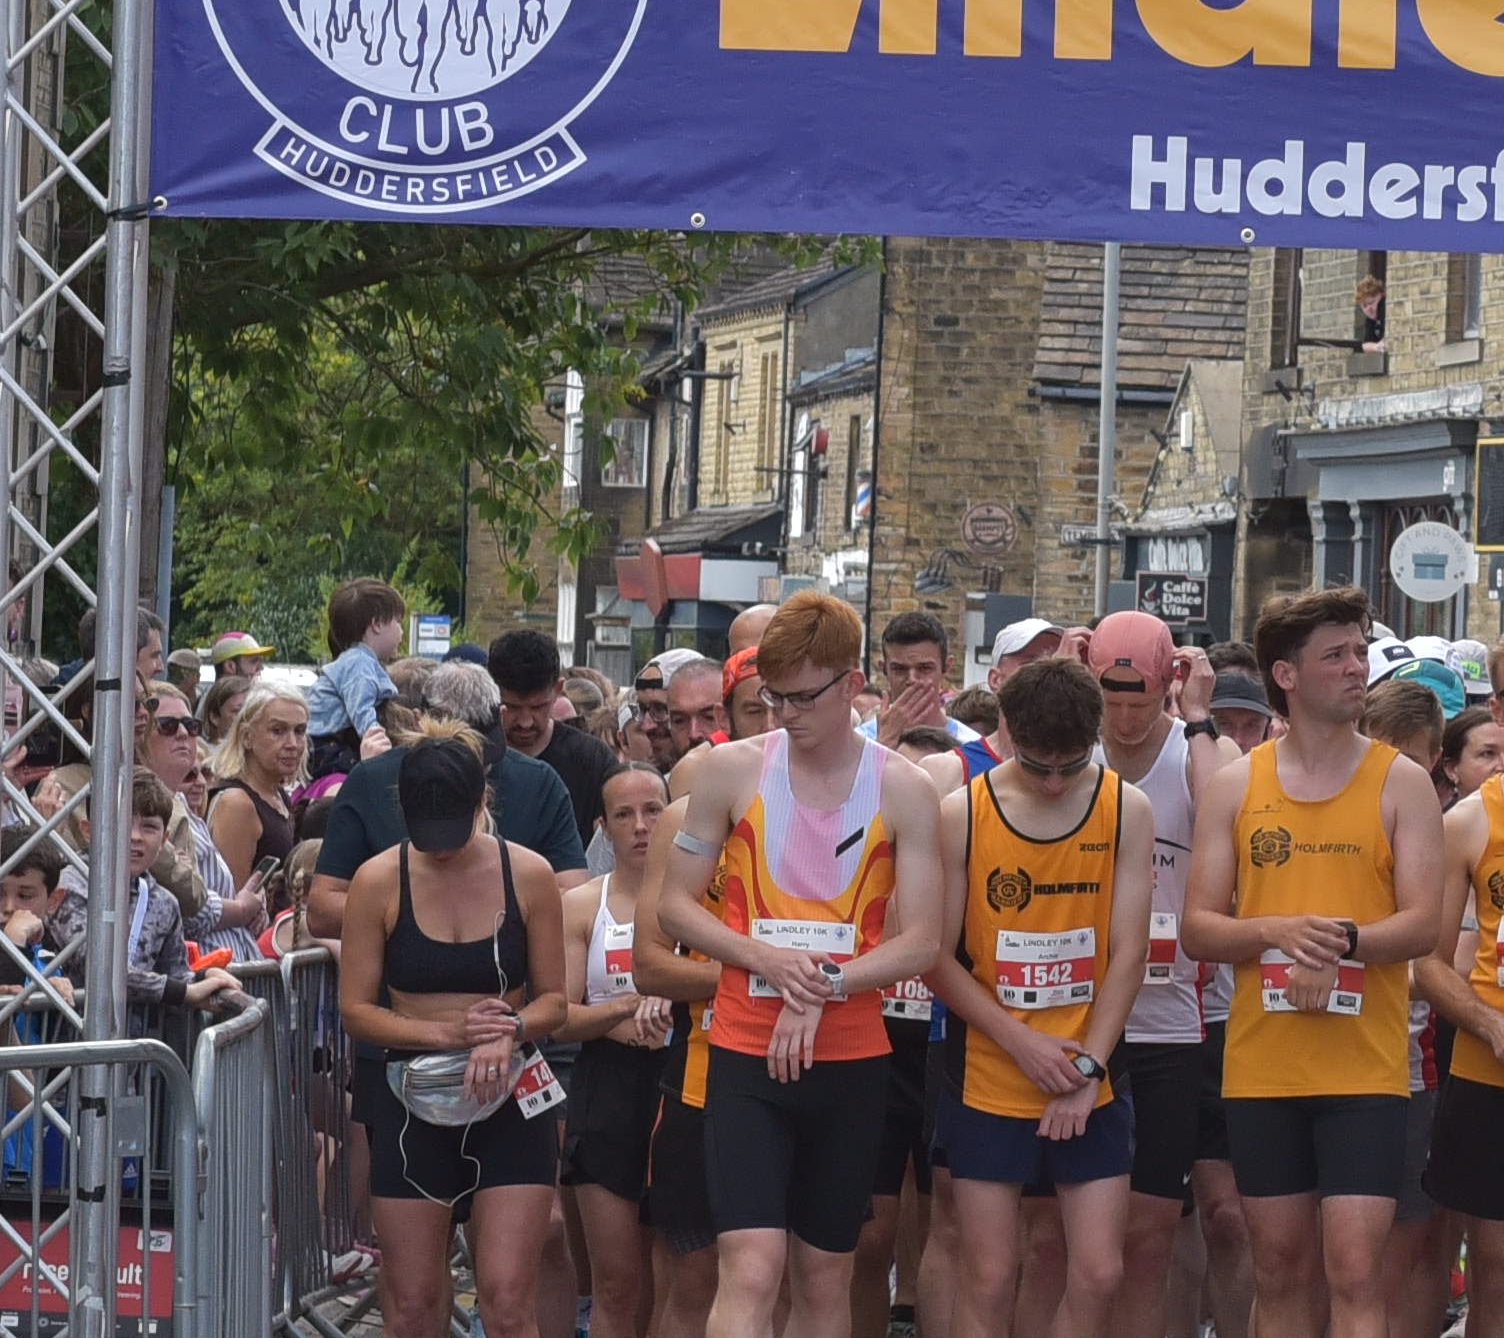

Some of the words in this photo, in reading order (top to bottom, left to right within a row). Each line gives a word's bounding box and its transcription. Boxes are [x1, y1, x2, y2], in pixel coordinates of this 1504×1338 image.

[338, 95, 495, 156] CLUB
[280, 136, 559, 203] HUDDERSFIELD
[1162, 593, 1202, 605] Dolce
[1162, 604, 1191, 616] Vita
[1294, 842, 1363, 855] HOLMFIRTH
[776, 925, 810, 935] LINDLEY
[1023, 939, 1057, 947] LINDLEY
[1021, 963, 1073, 986] 1542
